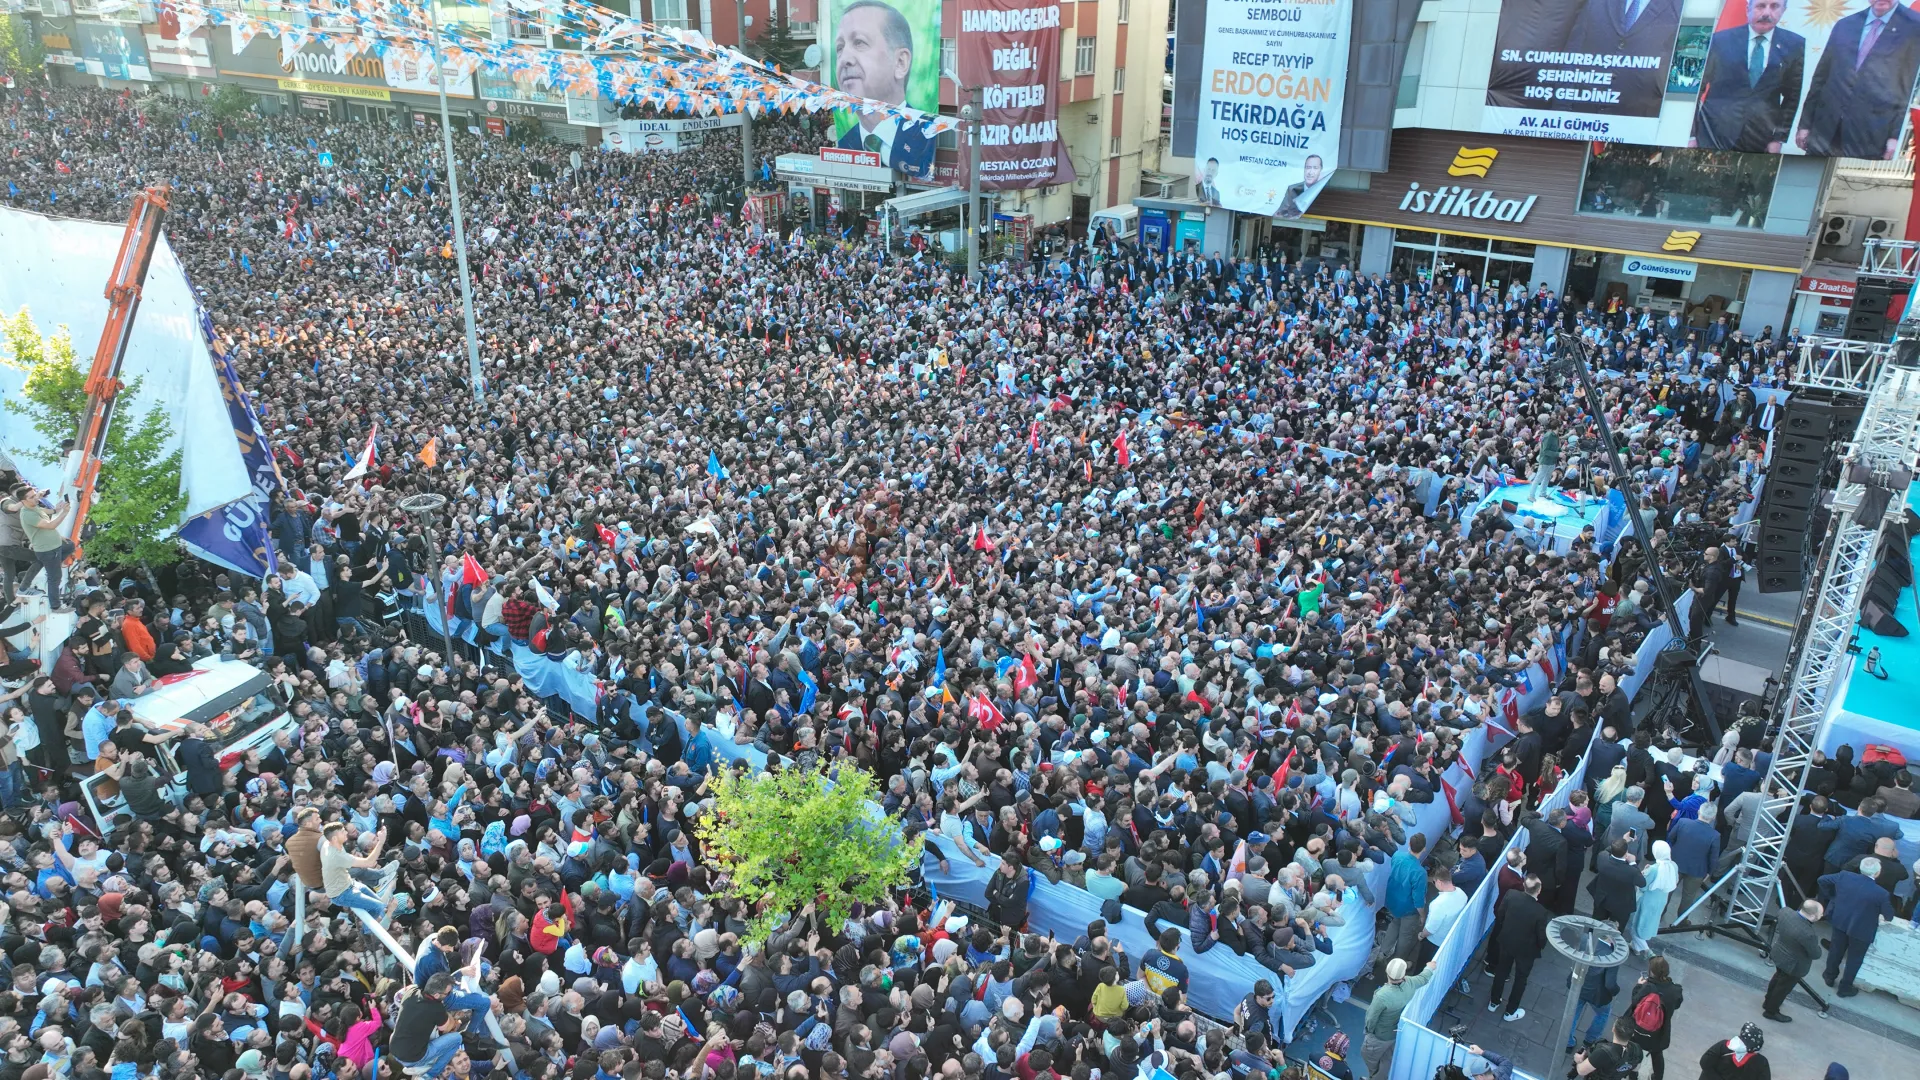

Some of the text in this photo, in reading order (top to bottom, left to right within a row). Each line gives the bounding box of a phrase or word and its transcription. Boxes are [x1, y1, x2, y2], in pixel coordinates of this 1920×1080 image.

[1247, 7, 1302, 22] SEMBOLÜ
[1232, 51, 1314, 69] RECEP TAYYİP
[1501, 49, 1661, 69] SN. CUMHURBAŞKANIM
[1537, 68, 1613, 85] ŞEHRİMİZE
[351, 88, 385, 98] KAMPANYA
[1211, 68, 1331, 103] ERDOĞAN
[983, 84, 1044, 109] KÖFTELER
[1524, 86, 1621, 104] HOŞ GELDİNİZ
[639, 120, 671, 131] İDEAL
[1502, 128, 1513, 136] AK
[1519, 116, 1610, 134] AV. ALİ GÜMÜŞ
[1222, 127, 1310, 149] HOŞ GELDİNİZ
[823, 151, 853, 164] HAKAN
[854, 153, 877, 166] BÜFE
[1021, 156, 1056, 169] ÖZCAN
[1239, 155, 1288, 167] MESTAN ÖZCAN
[834, 182, 881, 192] HAKAN BÜFE
[1398, 181, 1539, 223] istikbal
[1641, 264, 1692, 276] GÜMÜŞSUYU
[1818, 282, 1856, 293] Ziraat Ban
